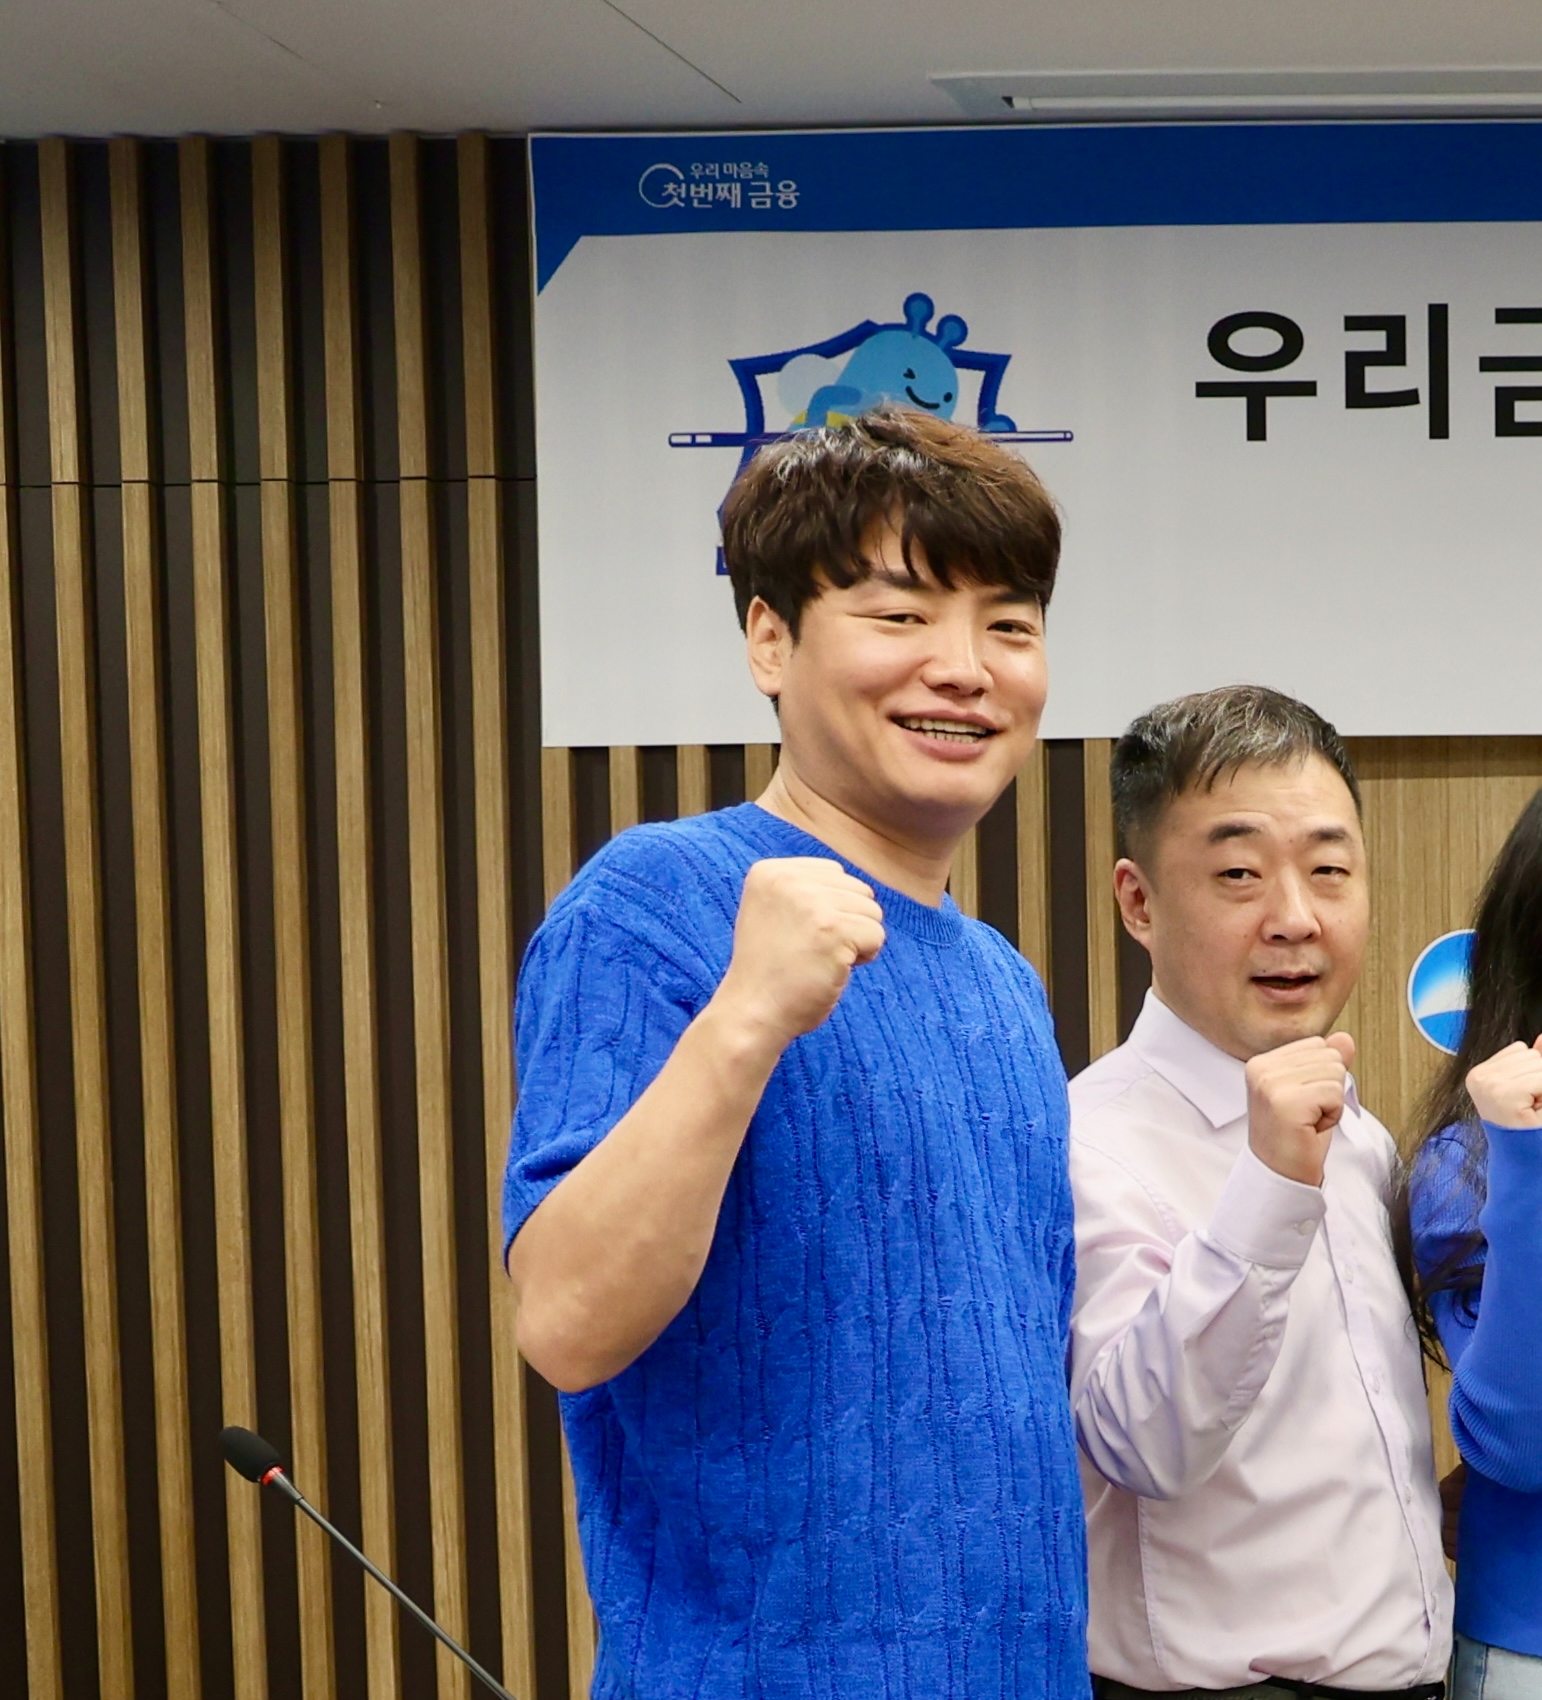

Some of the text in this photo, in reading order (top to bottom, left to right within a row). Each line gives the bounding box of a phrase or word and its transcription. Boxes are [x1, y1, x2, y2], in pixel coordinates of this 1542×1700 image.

[690, 162, 769, 179] 우리 마음속
[661, 180, 800, 209] 첫번째 금융
